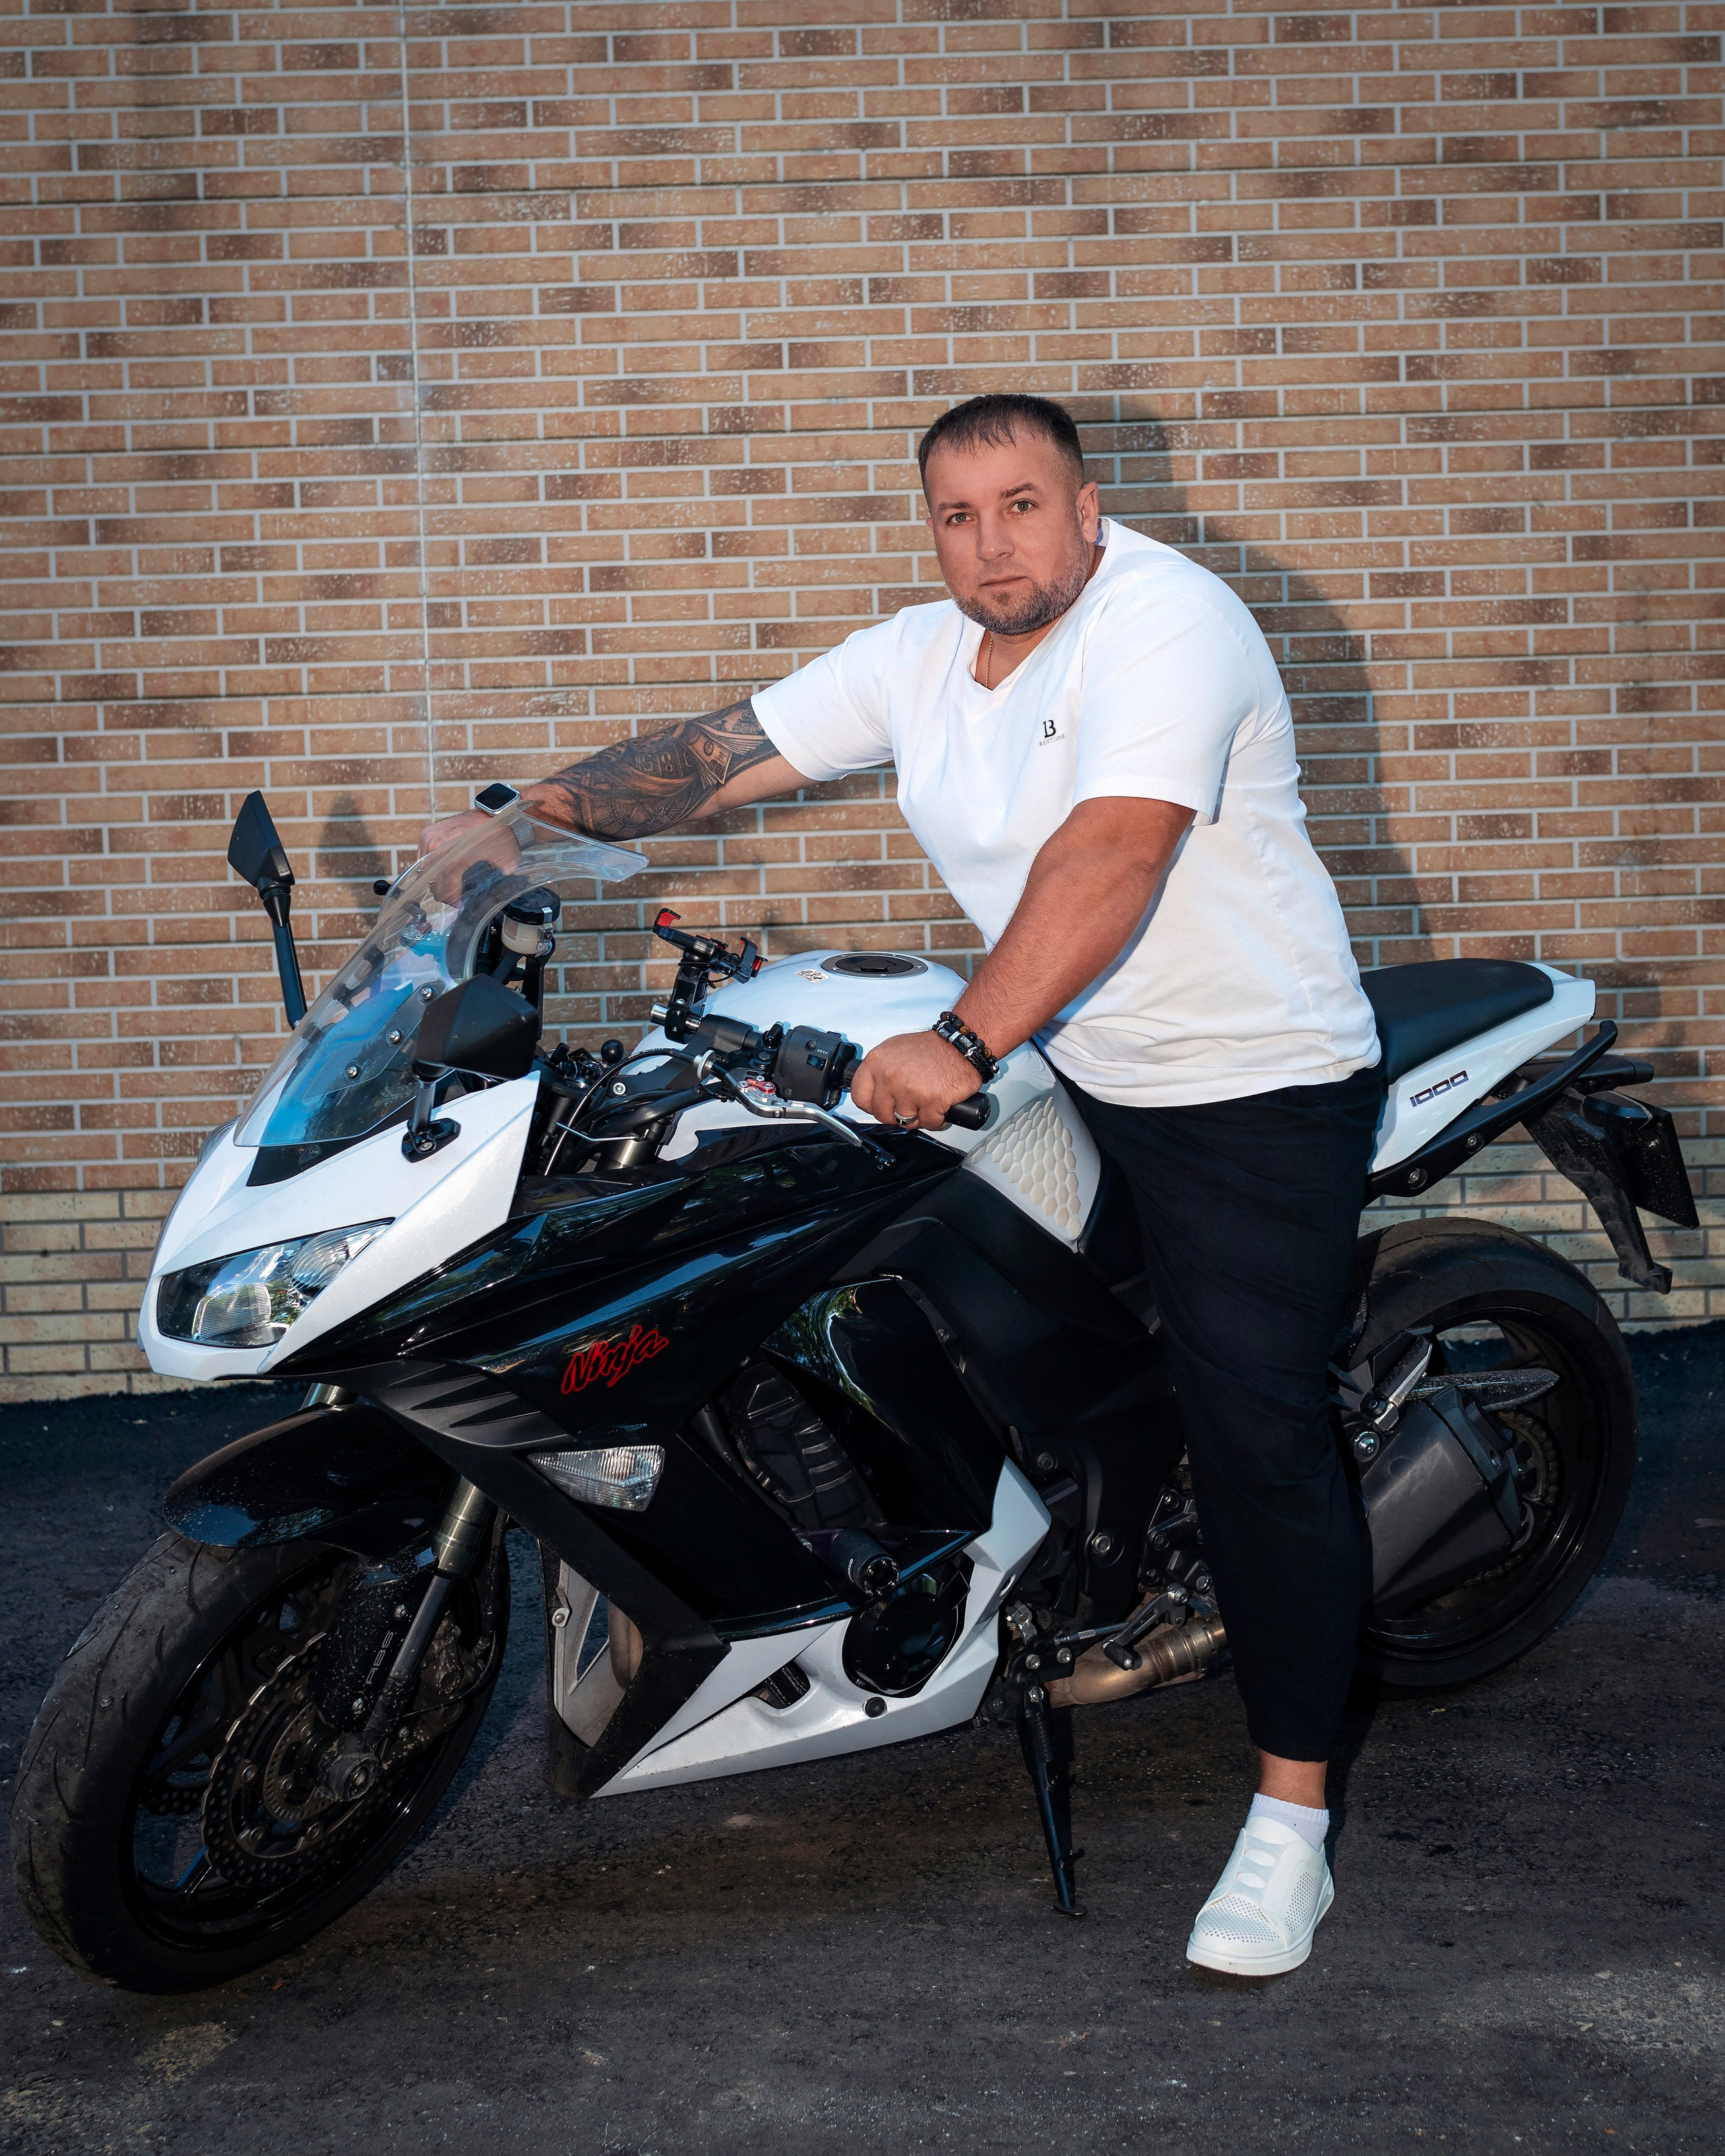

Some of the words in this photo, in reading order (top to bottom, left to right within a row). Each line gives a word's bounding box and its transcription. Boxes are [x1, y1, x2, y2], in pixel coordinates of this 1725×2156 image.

[1042, 720, 1057, 738] B
[1409, 1070, 1469, 1107] 1000
[561, 1325, 669, 1395] Ninja
[365, 1630, 394, 1684] ABS
